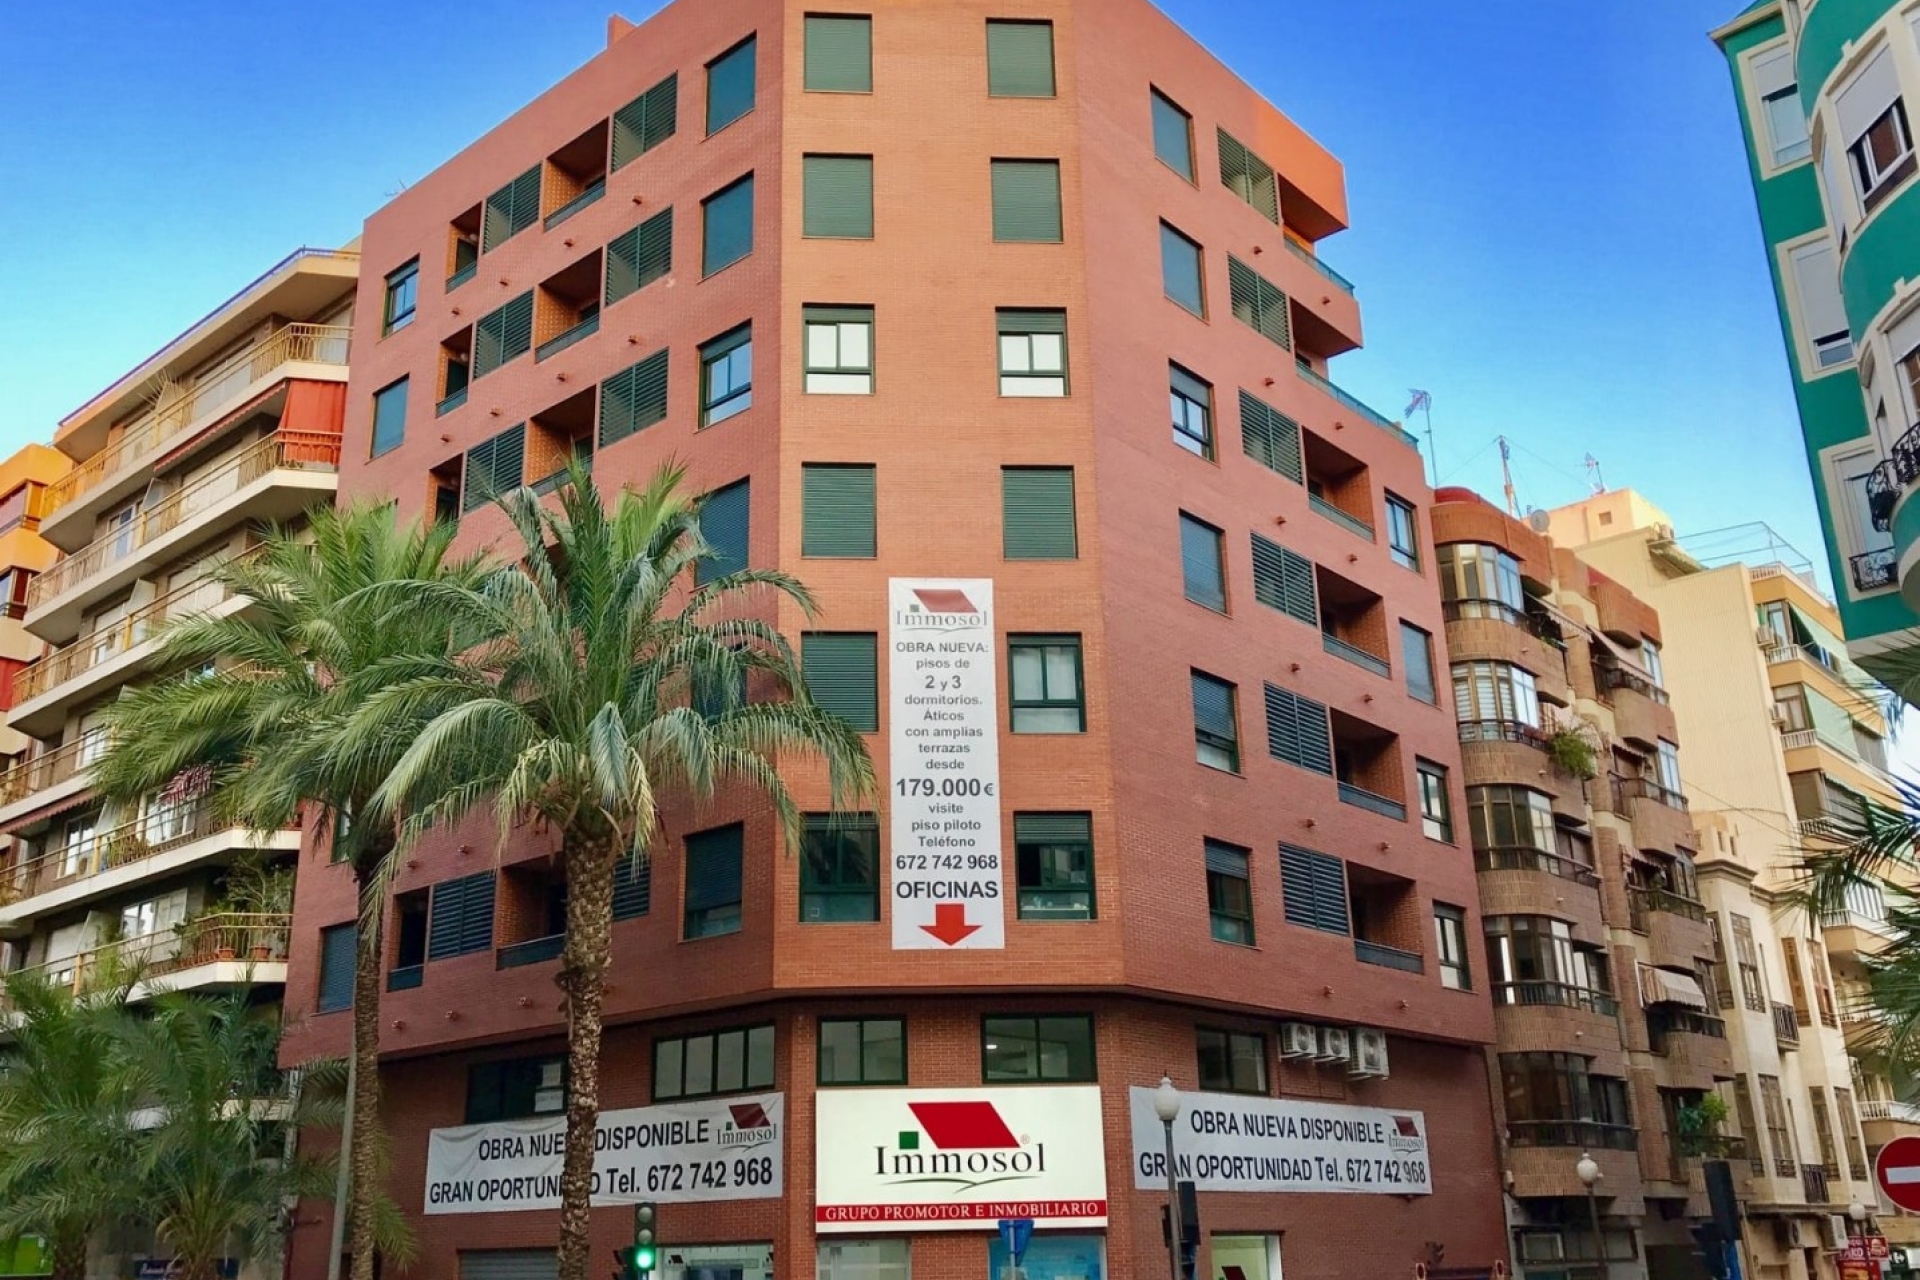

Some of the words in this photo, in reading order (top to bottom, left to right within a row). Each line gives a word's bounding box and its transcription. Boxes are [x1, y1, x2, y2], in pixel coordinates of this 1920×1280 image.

[897, 610, 988, 626] Immosol
[896, 642, 934, 653] OBRA
[916, 658, 951, 670] pisos
[954, 658, 970, 669] de
[925, 675, 935, 689] 2
[940, 681, 948, 691] y
[952, 675, 962, 689] 3
[904, 694, 983, 705] dormitorios.
[923, 708, 965, 721] Áticos
[905, 729, 929, 738] con
[933, 726, 983, 739] amplias
[919, 743, 971, 753] terrazas
[925, 759, 965, 770] desde
[928, 803, 964, 814] visite
[911, 820, 941, 832] piso
[944, 819, 982, 832] piloto
[918, 835, 976, 848] Teléfono
[896, 854, 928, 870] 672
[932, 854, 963, 870] 742
[967, 854, 998, 870] 968
[896, 881, 999, 899] OFICINAS
[717, 1123, 778, 1145] Immosol
[1190, 1109, 1240, 1136] OBRA
[1243, 1112, 1298, 1139] NUEVA
[1300, 1117, 1385, 1143] DISPONIBLE
[478, 1136, 524, 1160] OBRA
[594, 1119, 710, 1151] DISPONIBLE
[873, 1143, 1047, 1175] Immosol
[1196, 1154, 1313, 1181] OPORTUNIDAD
[1314, 1156, 1343, 1182] Tel.
[1346, 1158, 1373, 1183] 672
[1374, 1159, 1402, 1183] 742
[1403, 1160, 1426, 1183] 968
[430, 1180, 473, 1204] GRAN
[606, 1166, 640, 1194] Tel.
[647, 1163, 683, 1192] 672
[689, 1159, 727, 1189] 742
[733, 1156, 773, 1187] 968
[825, 1206, 880, 1221] GRUPO
[883, 1204, 971, 1219] PROMOTOR
[974, 1203, 986, 1217] E
[988, 1202, 1099, 1217] INMOBILIARIO
